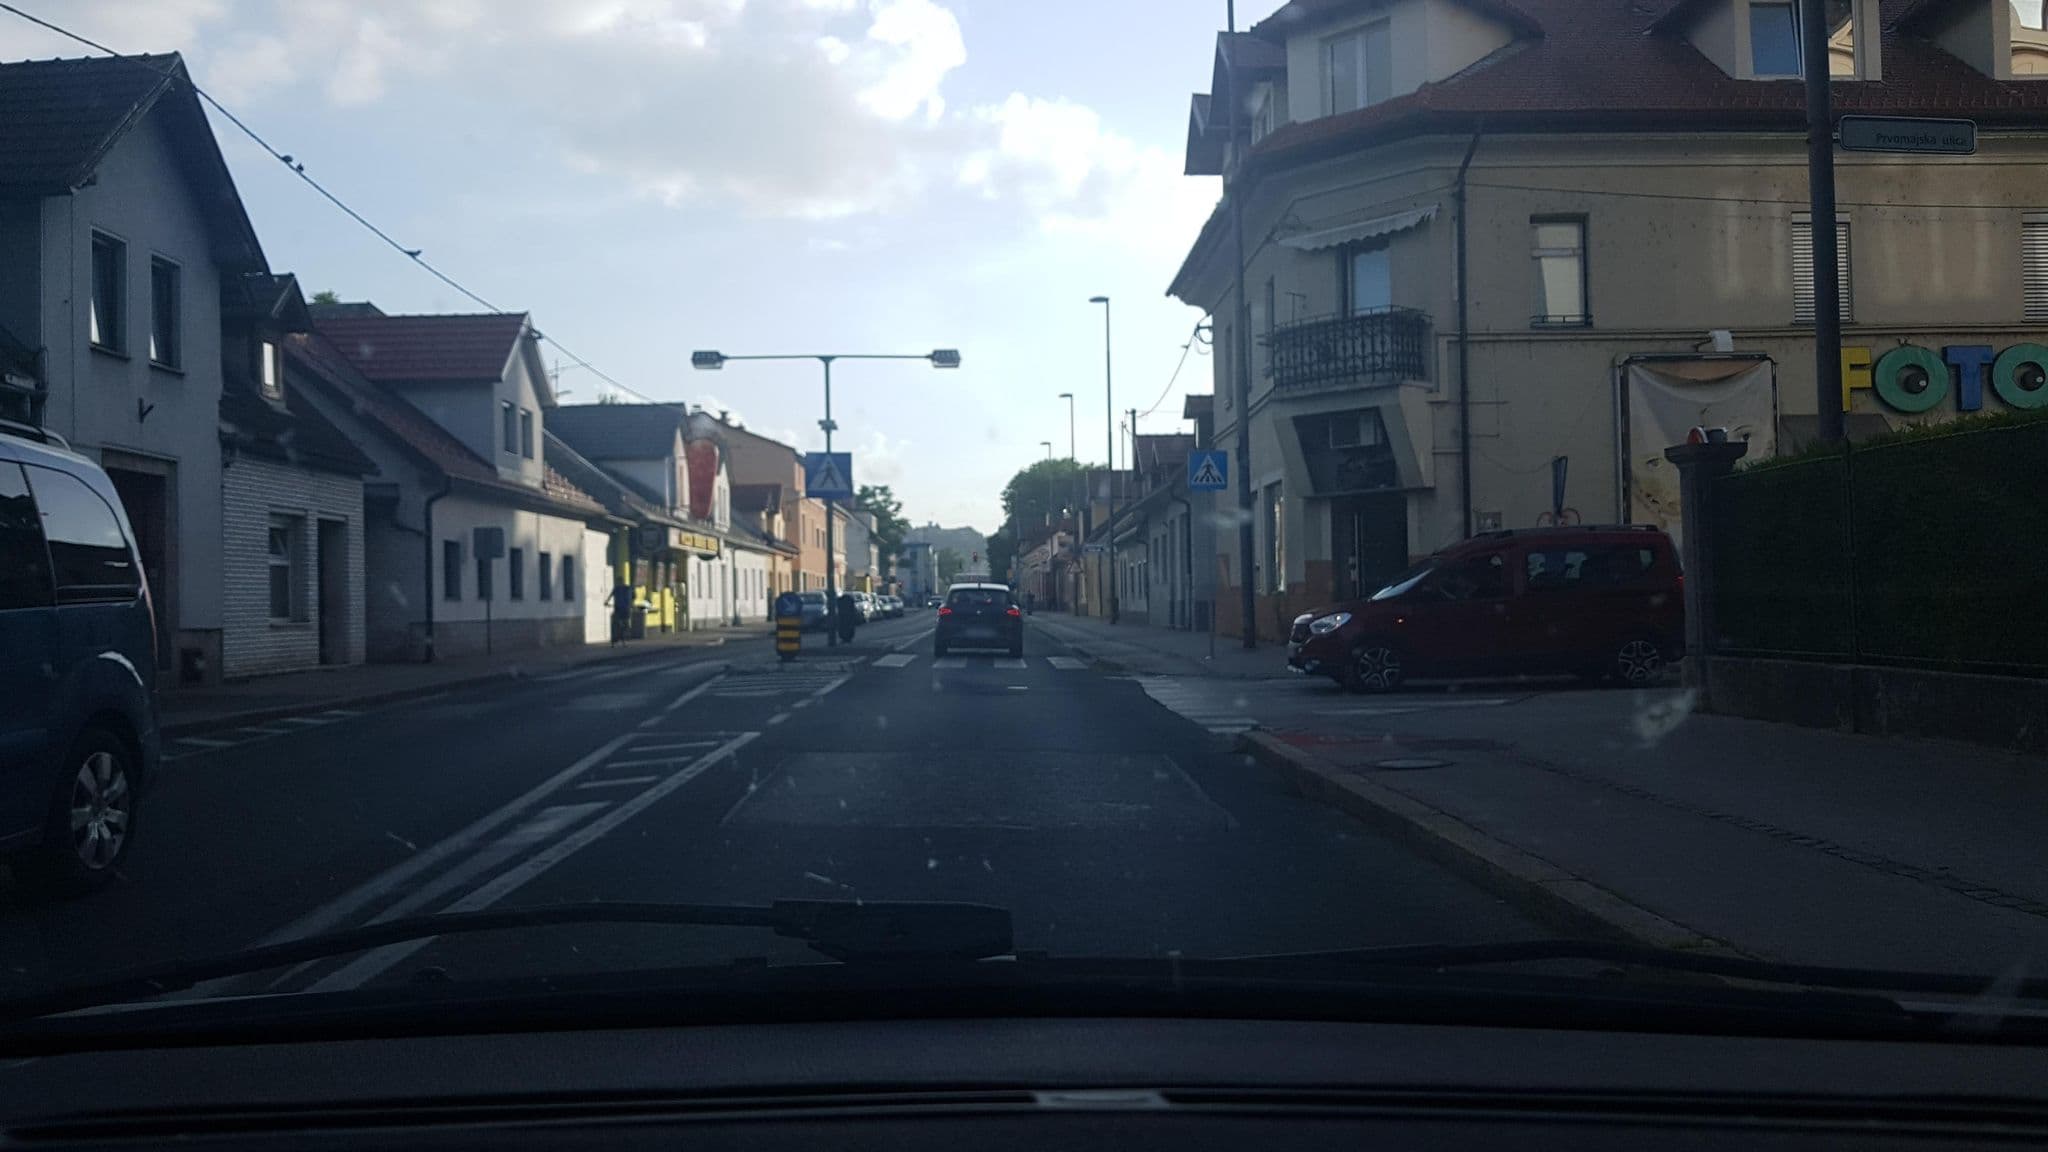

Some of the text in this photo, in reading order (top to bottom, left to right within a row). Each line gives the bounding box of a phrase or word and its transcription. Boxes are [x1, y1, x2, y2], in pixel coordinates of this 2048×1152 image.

[1876, 132, 1968, 147] Prvomajska ulica
[1840, 342, 2048, 414] FOTO
